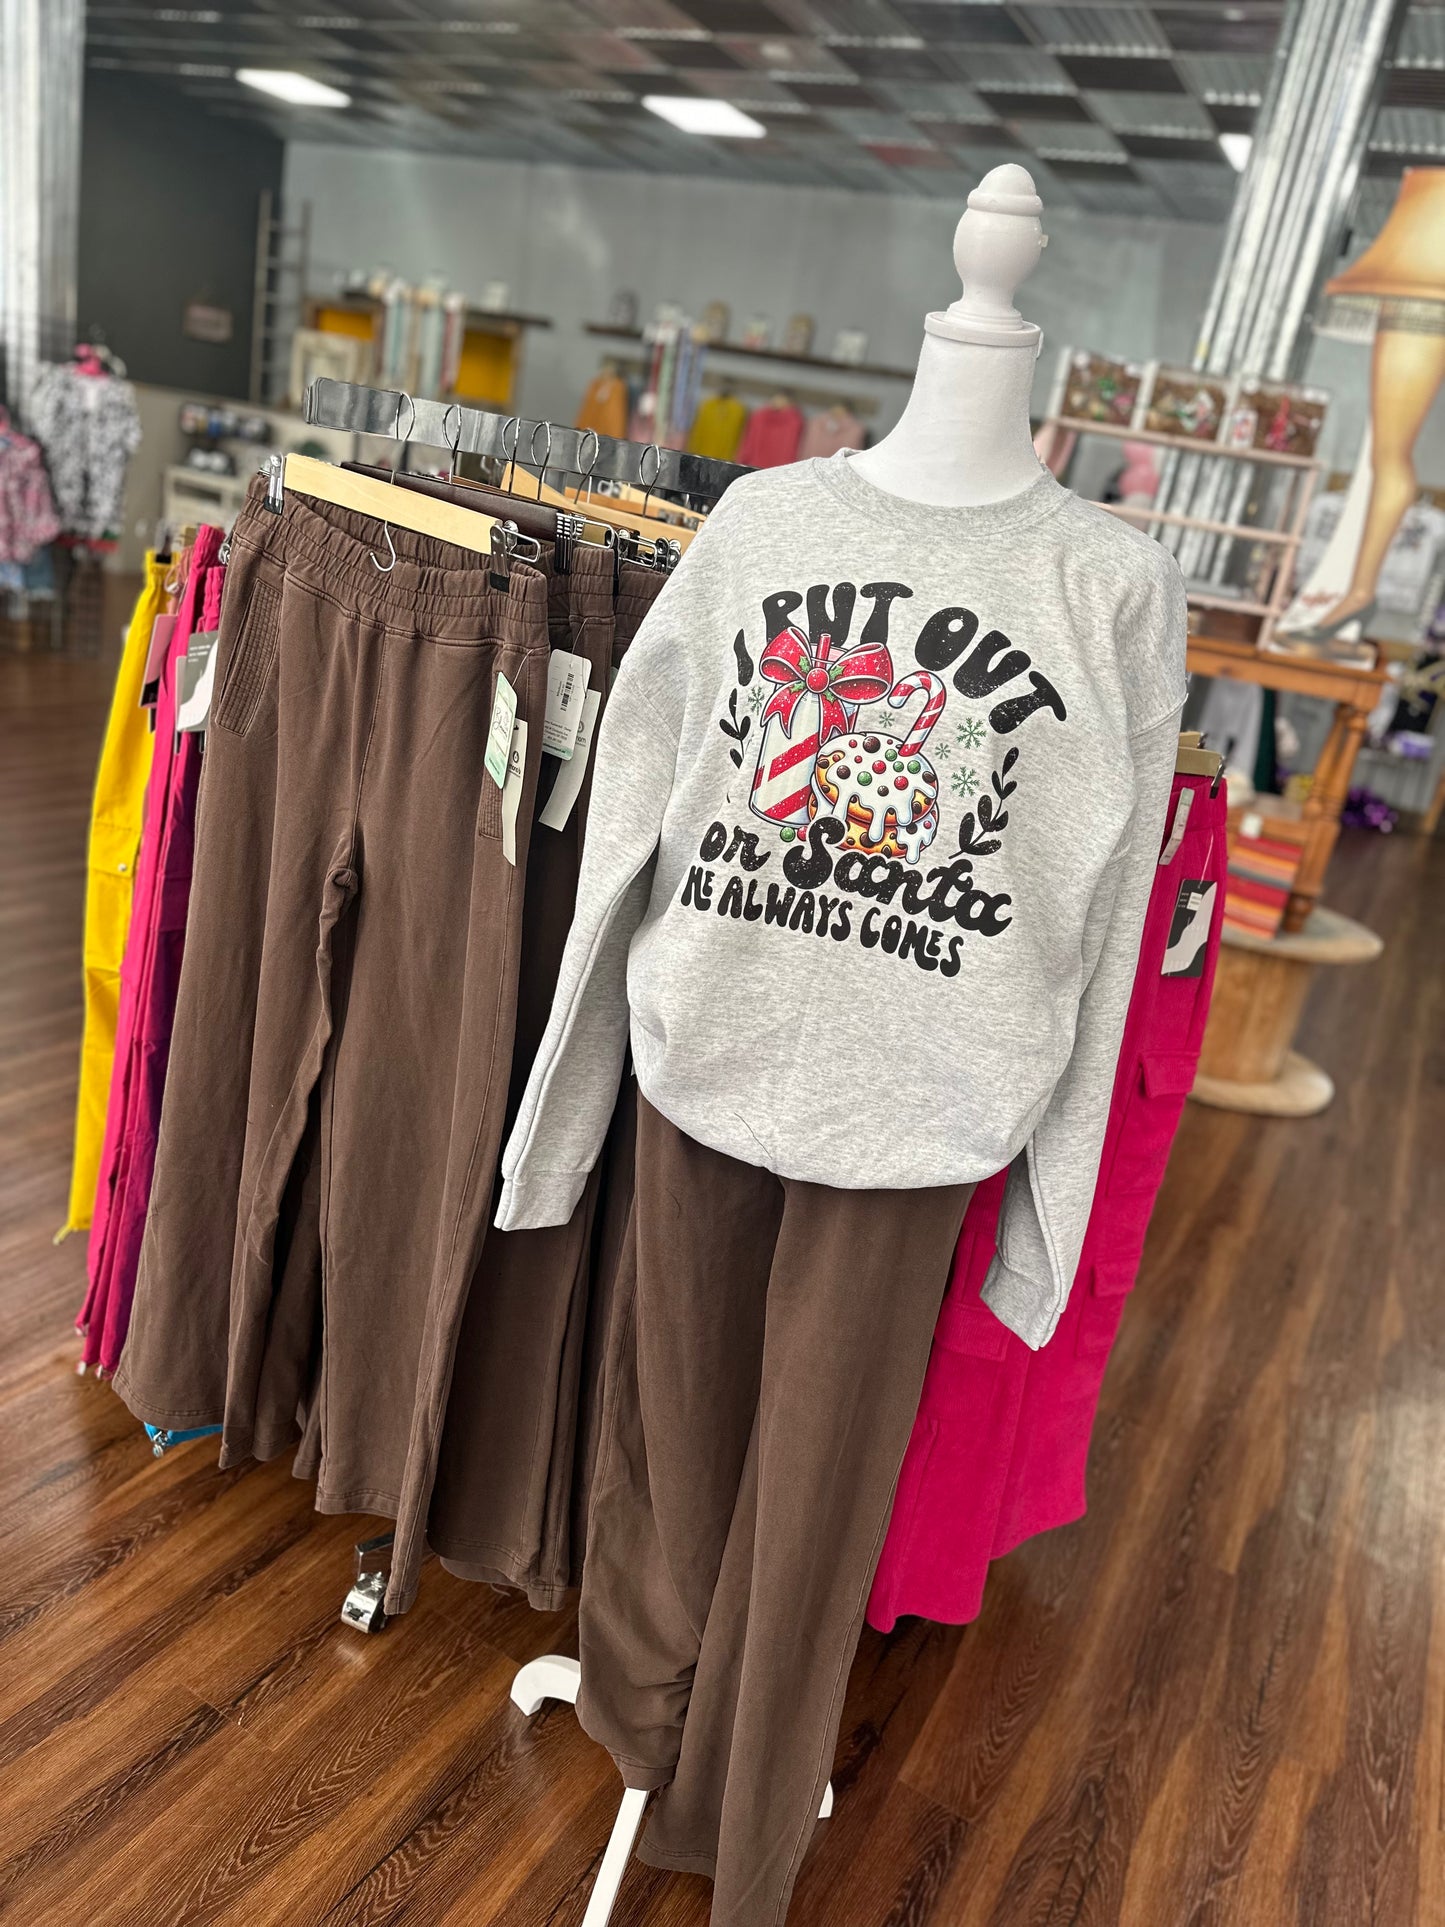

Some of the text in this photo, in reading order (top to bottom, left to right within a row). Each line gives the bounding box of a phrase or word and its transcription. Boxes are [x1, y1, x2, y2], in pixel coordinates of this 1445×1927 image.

[733, 581, 1068, 735] I PUT OUT
[699, 815, 1014, 938] on Santa
[716, 875, 853, 942] ALWAYS
[859, 906, 965, 978] COMES
